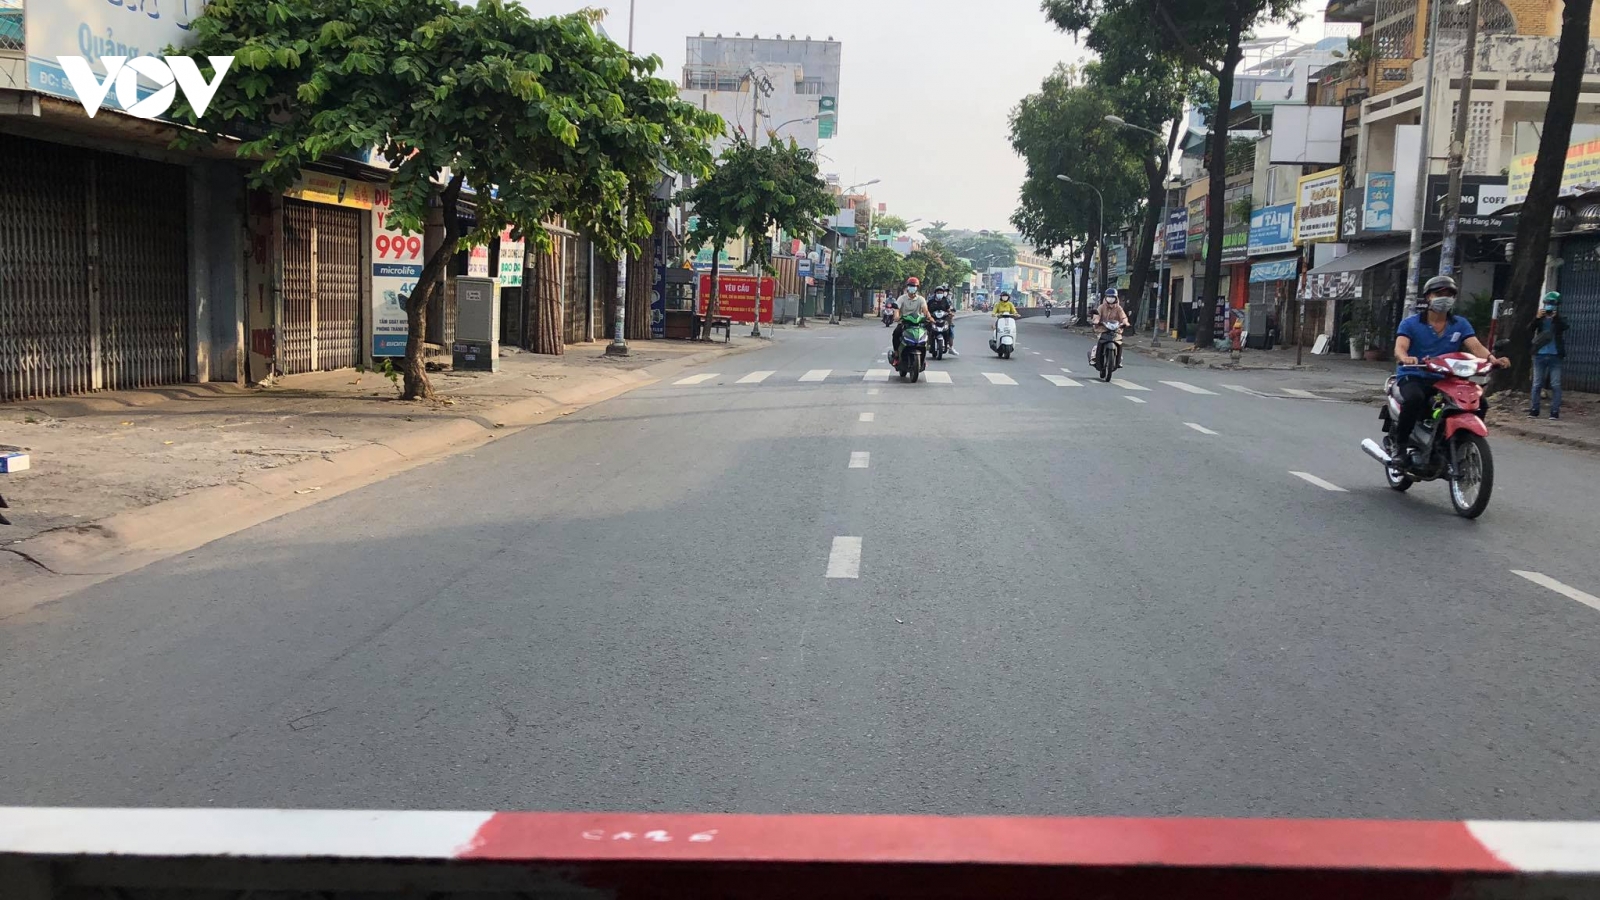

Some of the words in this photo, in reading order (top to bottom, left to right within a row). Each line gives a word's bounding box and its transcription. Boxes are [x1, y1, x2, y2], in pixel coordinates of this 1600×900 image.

[1482, 196, 1508, 204] COFF
[375, 234, 421, 260] 999
[380, 267, 415, 276] microlife
[725, 283, 736, 292] YÊU
